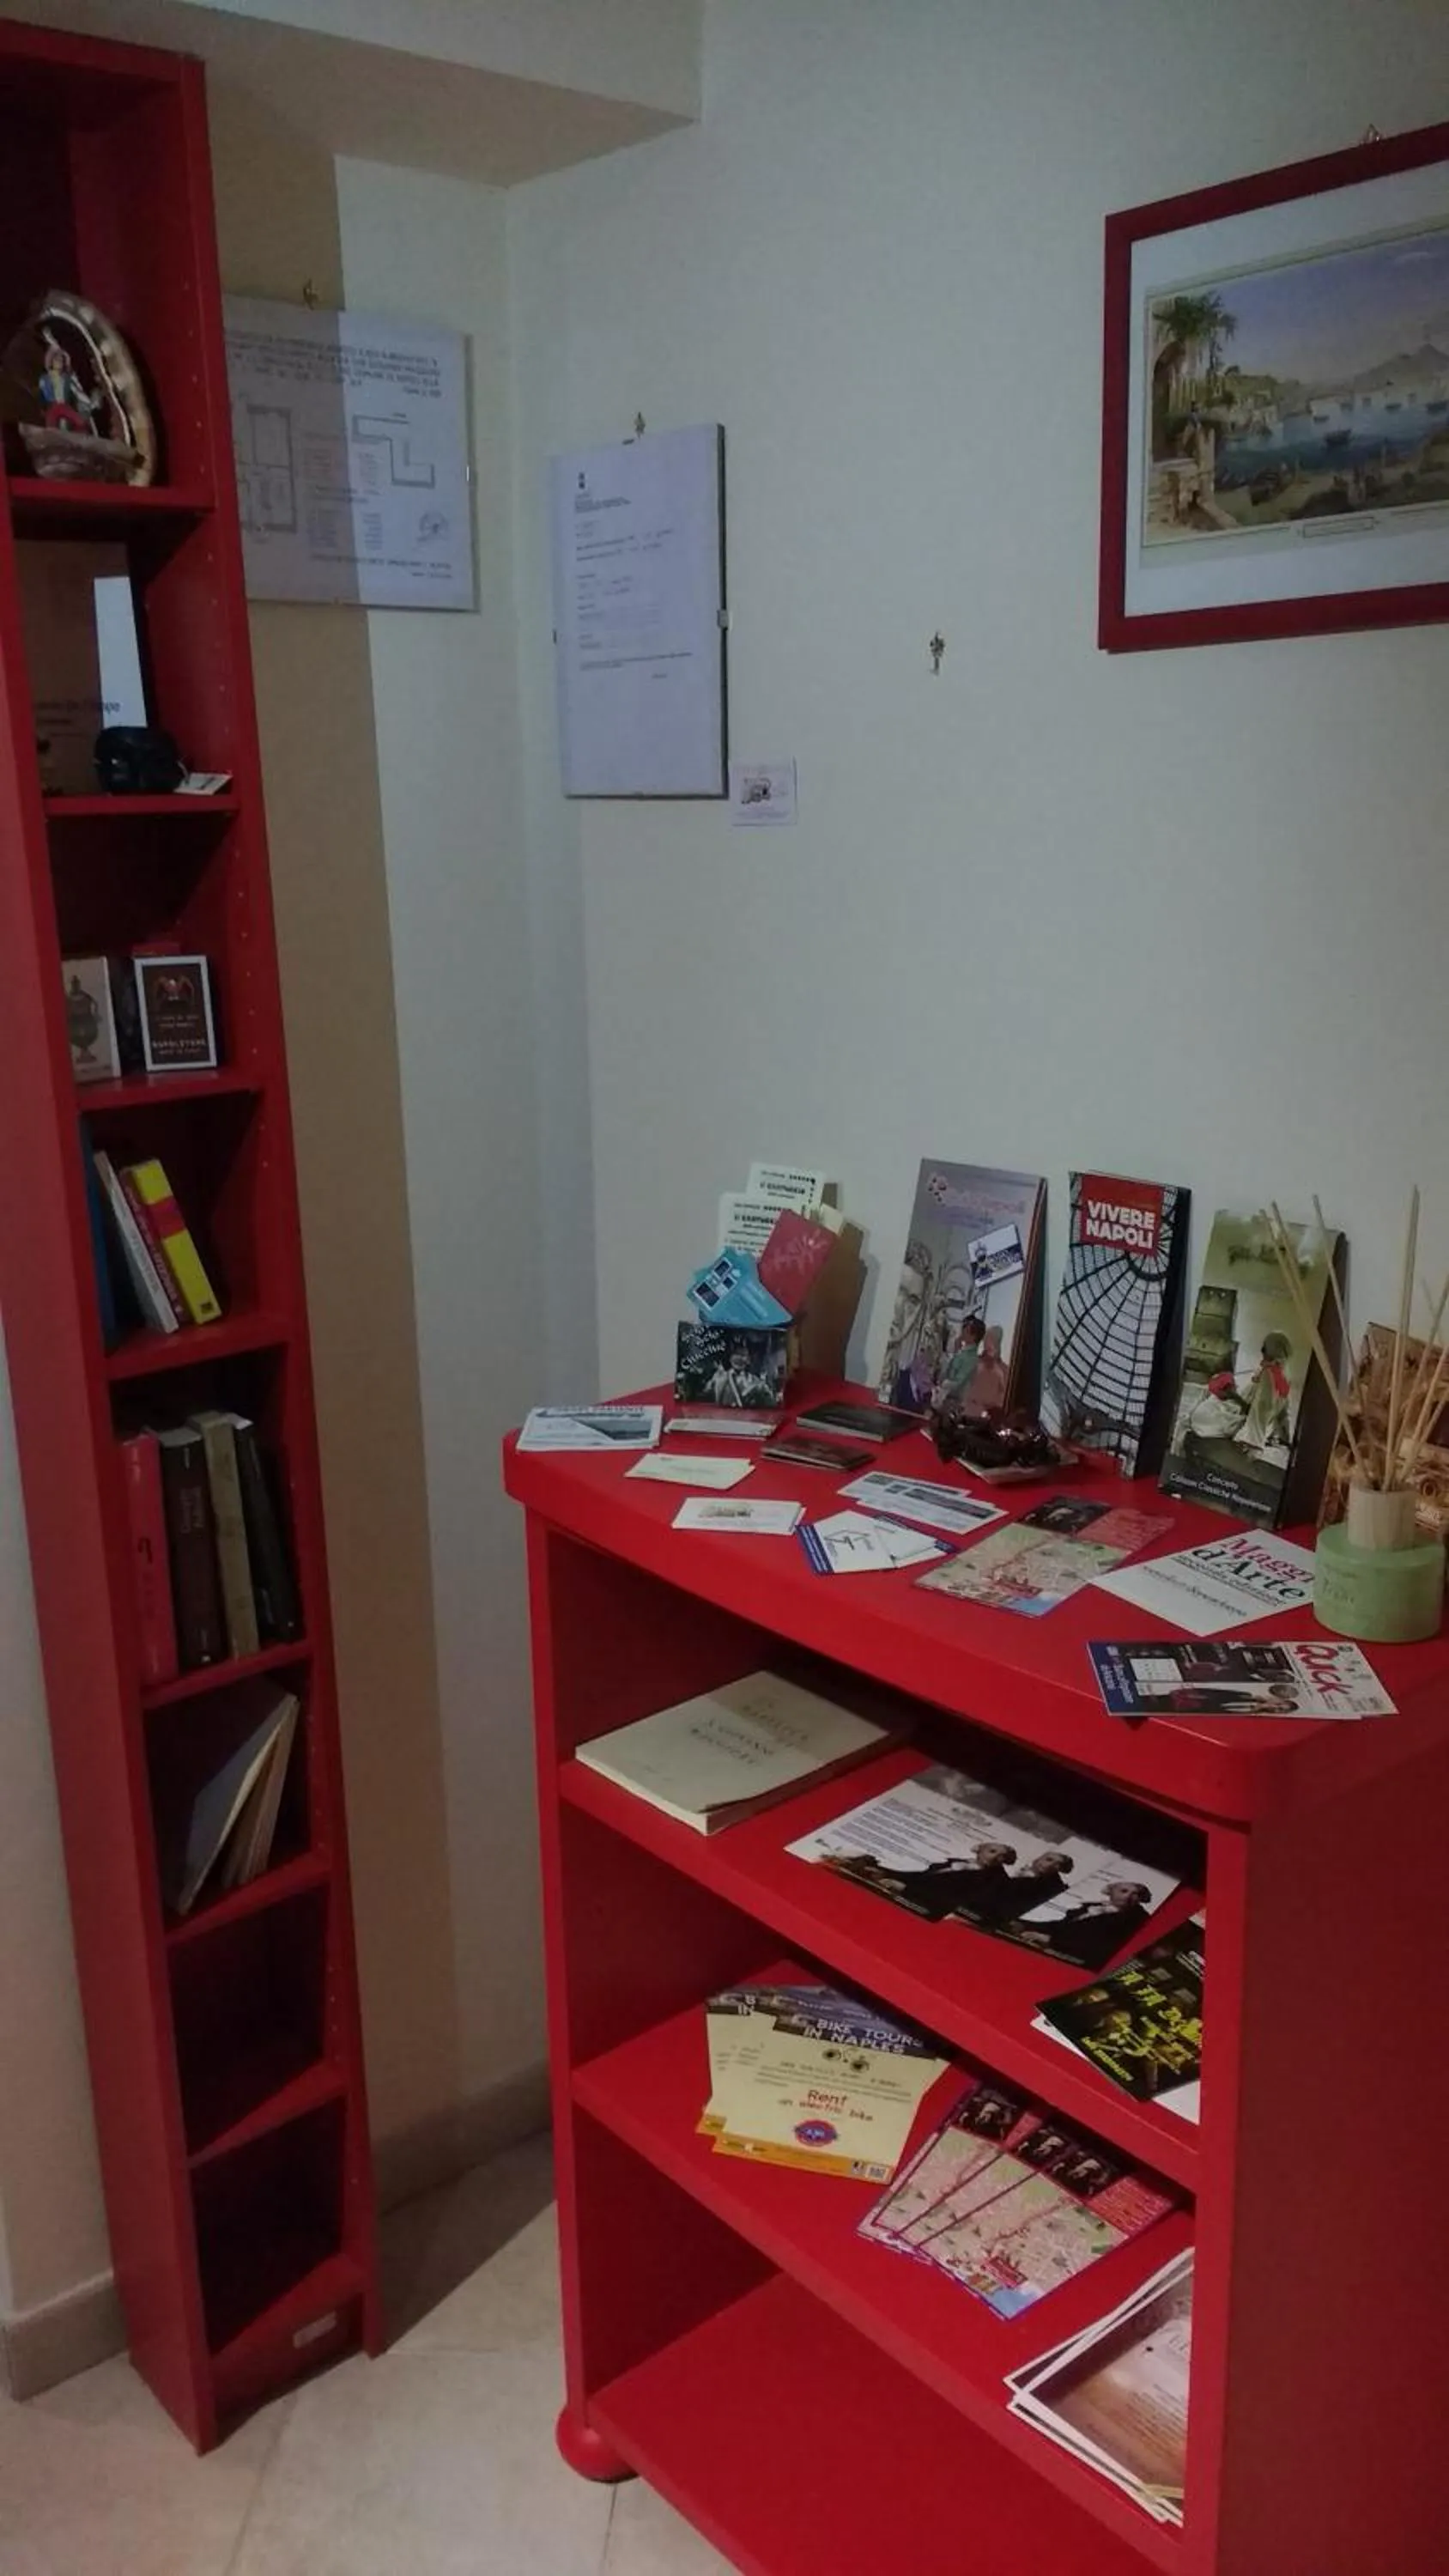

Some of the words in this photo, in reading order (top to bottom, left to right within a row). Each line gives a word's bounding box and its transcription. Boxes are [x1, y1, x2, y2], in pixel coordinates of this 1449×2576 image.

[1087, 1200, 1156, 1230] VIVERE
[1085, 1218, 1153, 1249] NAPOLI
[803, 2026, 823, 2040] IN
[831, 2032, 906, 2053] NAPLES
[816, 2019, 855, 2034] BIKE
[807, 2088, 848, 2105] Rent
